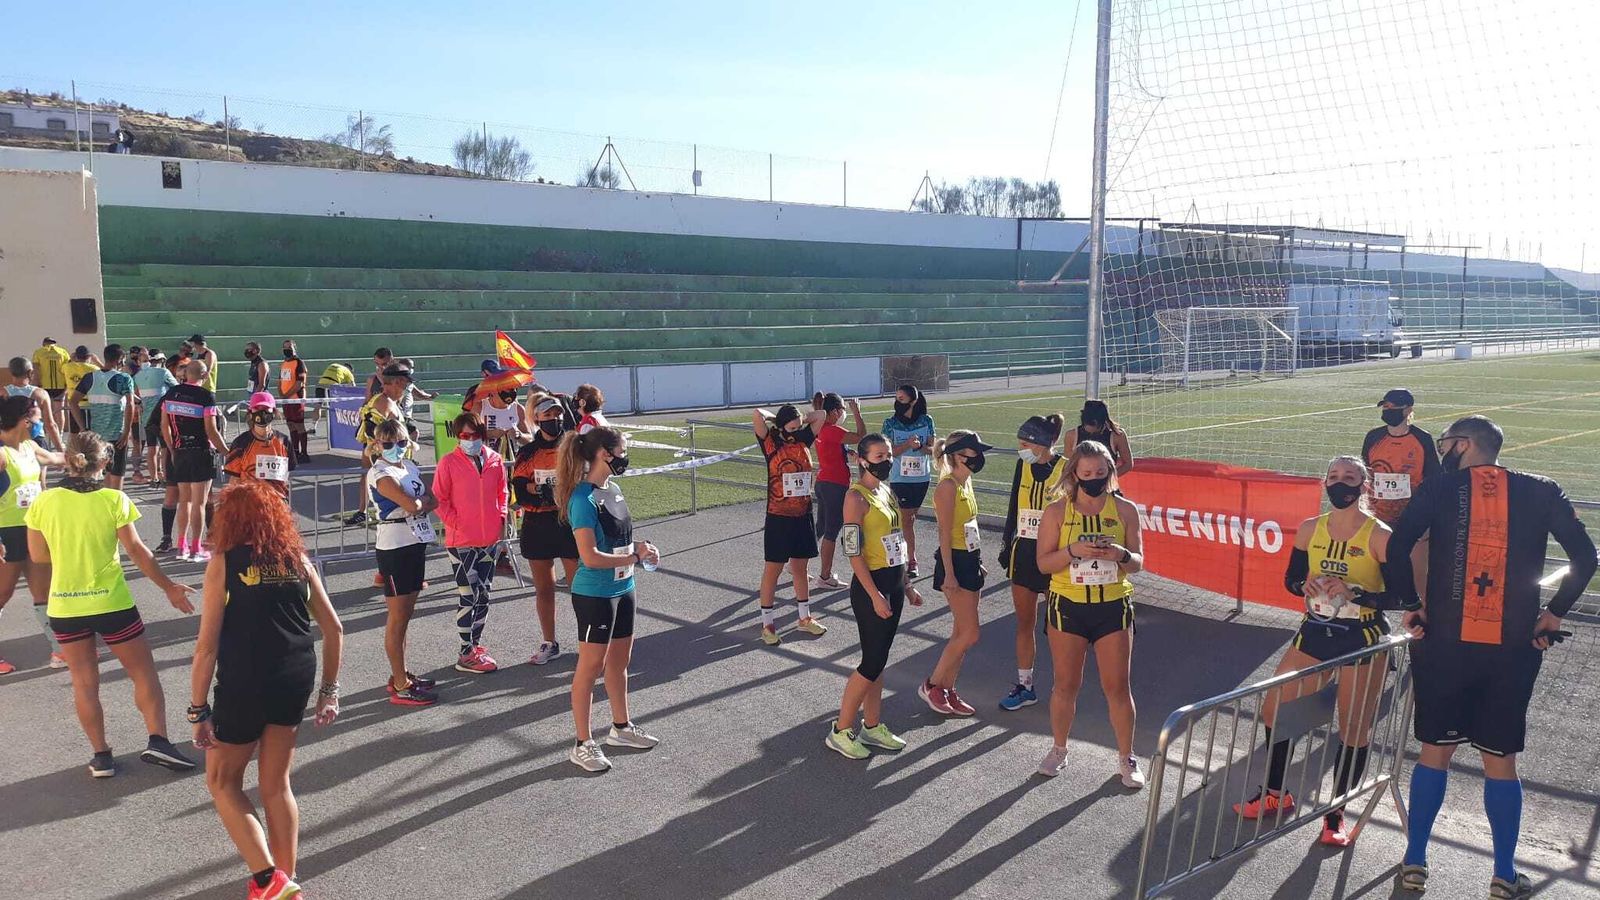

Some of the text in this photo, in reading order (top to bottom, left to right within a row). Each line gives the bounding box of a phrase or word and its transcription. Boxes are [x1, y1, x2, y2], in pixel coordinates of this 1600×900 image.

[266, 462, 281, 470] 107
[908, 461, 921, 469] 150
[794, 479, 804, 487] 19
[1385, 480, 1397, 489] 79
[1136, 503, 1283, 554] MENINO
[1456, 528, 1466, 541] DE
[895, 542, 900, 552] 5
[1091, 561, 1099, 570] 4
[1320, 560, 1348, 573] OTIS
[1452, 543, 1465, 601] DIPUTACIÓN
